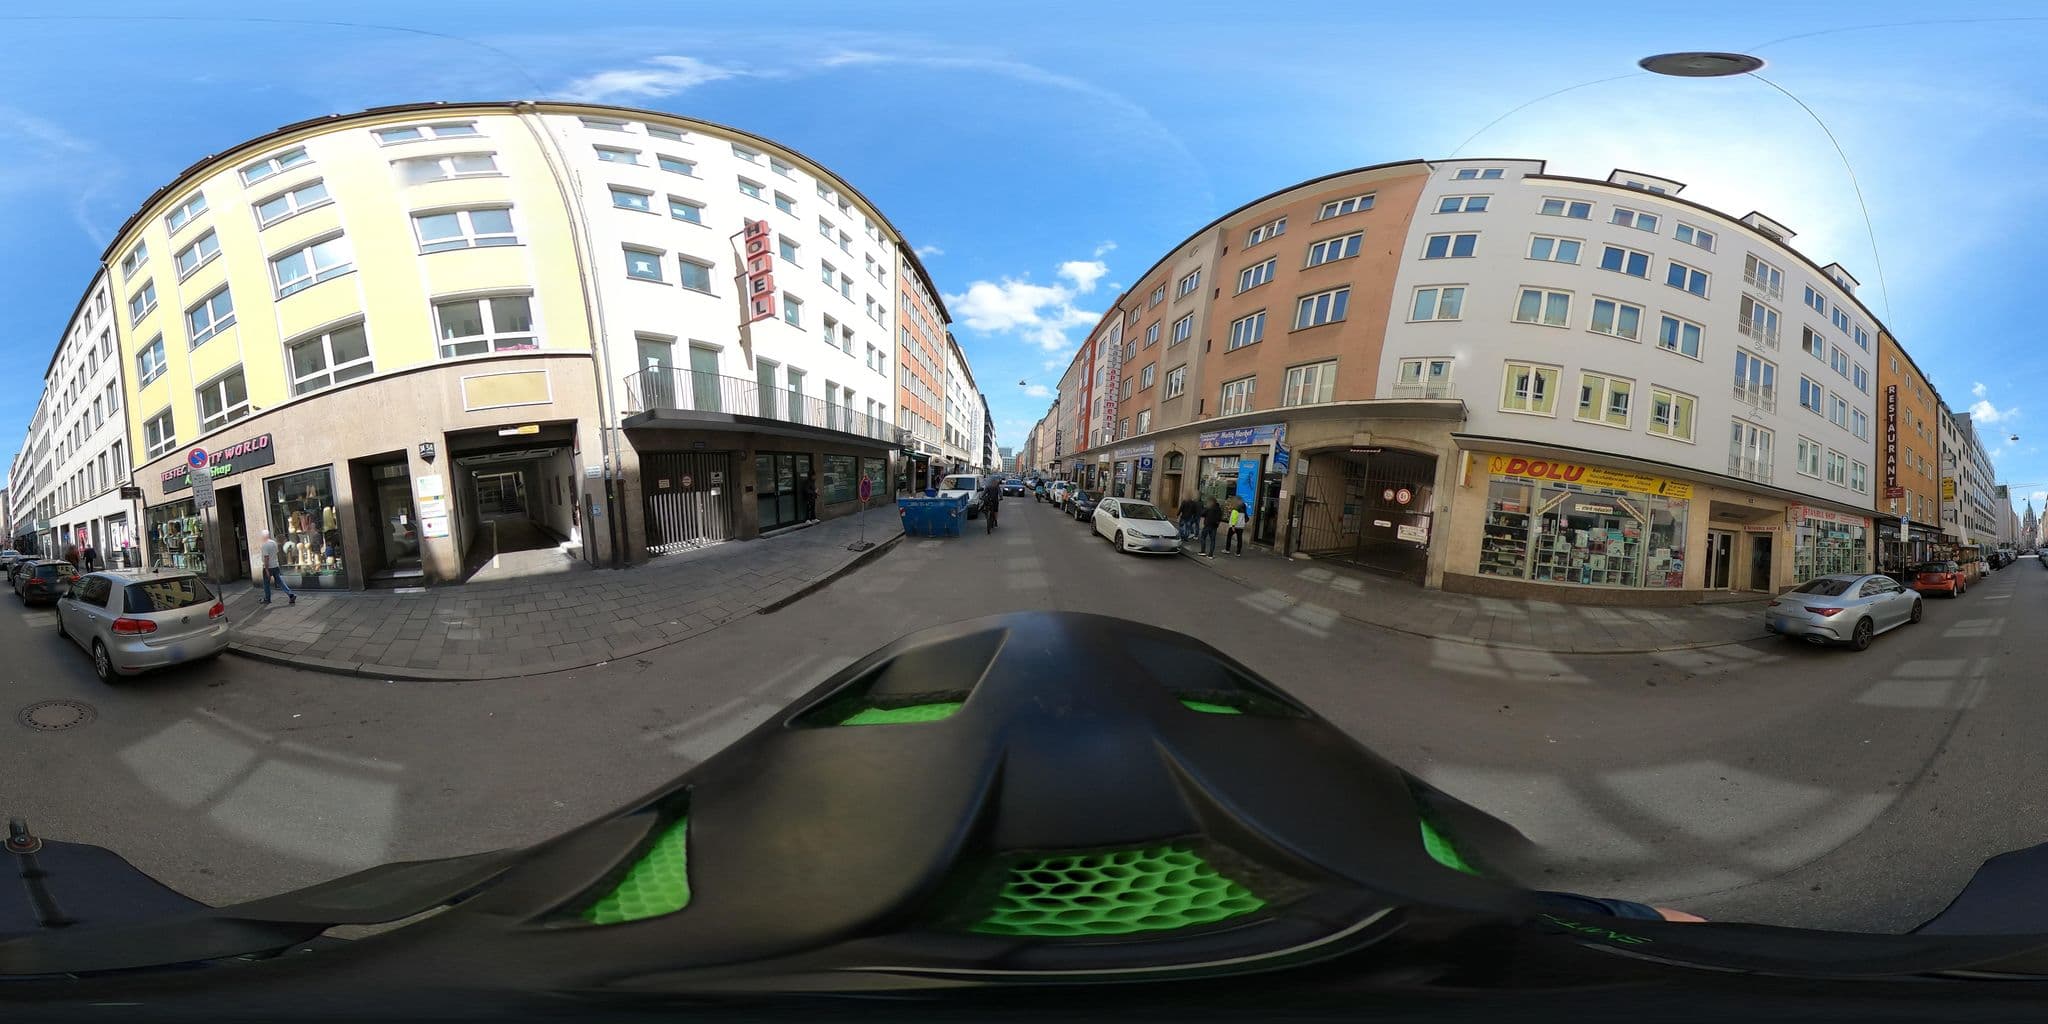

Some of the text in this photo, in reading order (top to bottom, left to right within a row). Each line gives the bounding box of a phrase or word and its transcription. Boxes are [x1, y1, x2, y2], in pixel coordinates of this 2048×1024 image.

[747, 222, 767, 316] HOTEL
[1106, 368, 1116, 428] apartment
[224, 436, 269, 460] WORLD
[1888, 385, 1896, 486] RESTAURANT
[1505, 458, 1585, 482] DOLU
